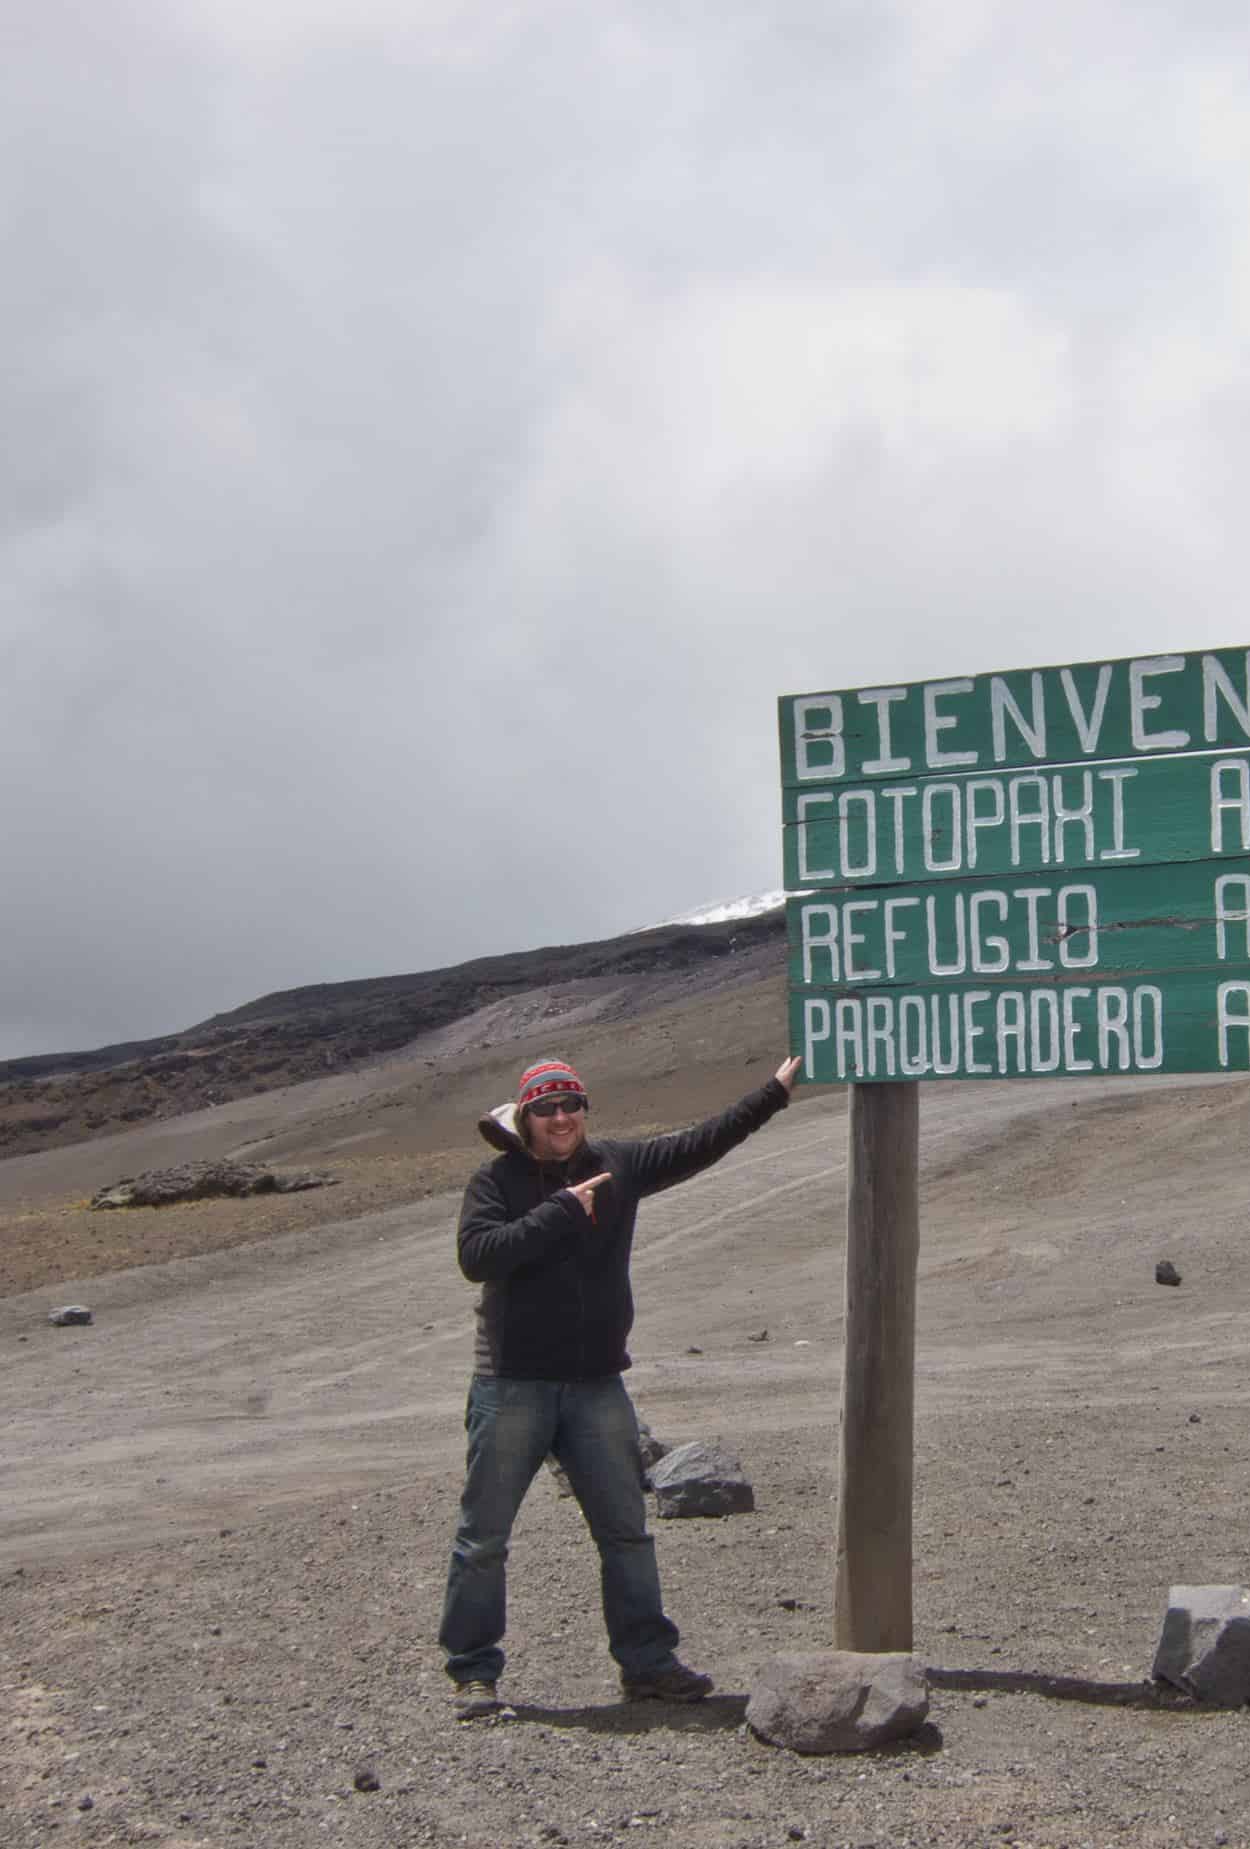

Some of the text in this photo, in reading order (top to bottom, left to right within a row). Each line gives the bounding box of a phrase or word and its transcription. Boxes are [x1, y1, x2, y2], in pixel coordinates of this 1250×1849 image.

[797, 767, 1140, 880] COTOPAXI
[801, 885, 1099, 984] REFUGIO
[804, 985, 1163, 1079] PARQUEADERO
